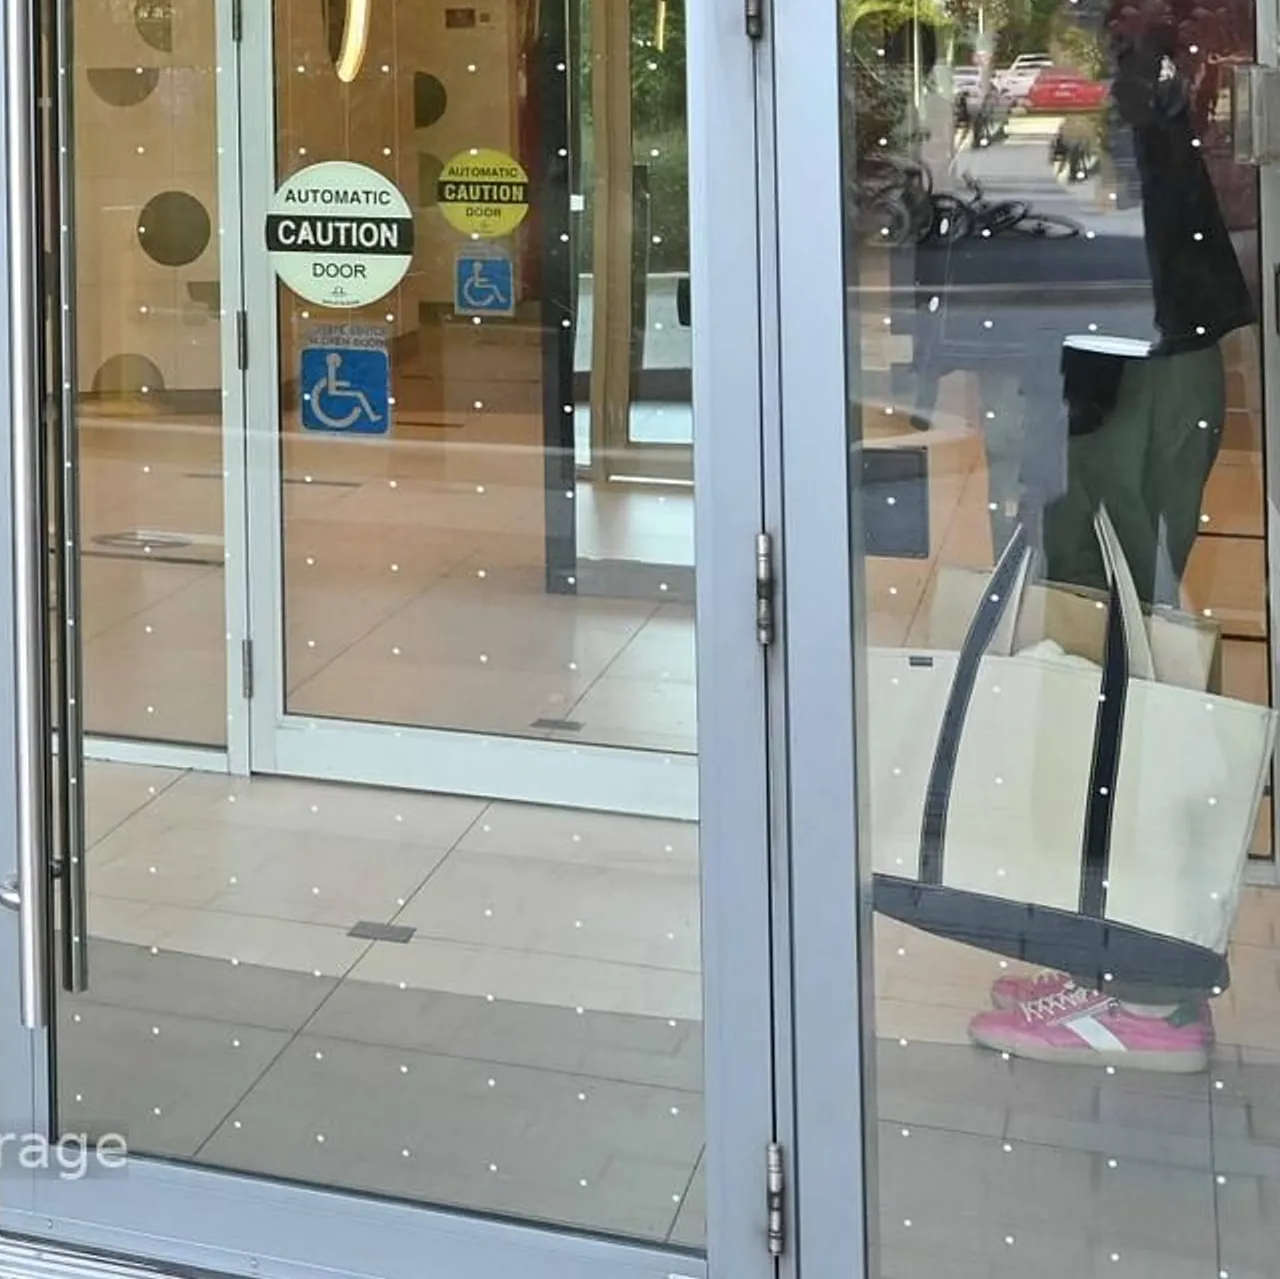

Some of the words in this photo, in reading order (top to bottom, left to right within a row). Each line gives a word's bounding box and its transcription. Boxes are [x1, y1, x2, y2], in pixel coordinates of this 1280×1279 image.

[448, 166, 518, 178] AUTOMATIC
[284, 188, 392, 205] AUTOMATIC
[443, 183, 524, 202] CAUTION
[465, 206, 502, 219] DOOR
[277, 220, 399, 248] CAUTION
[312, 262, 367, 279] DOOR
